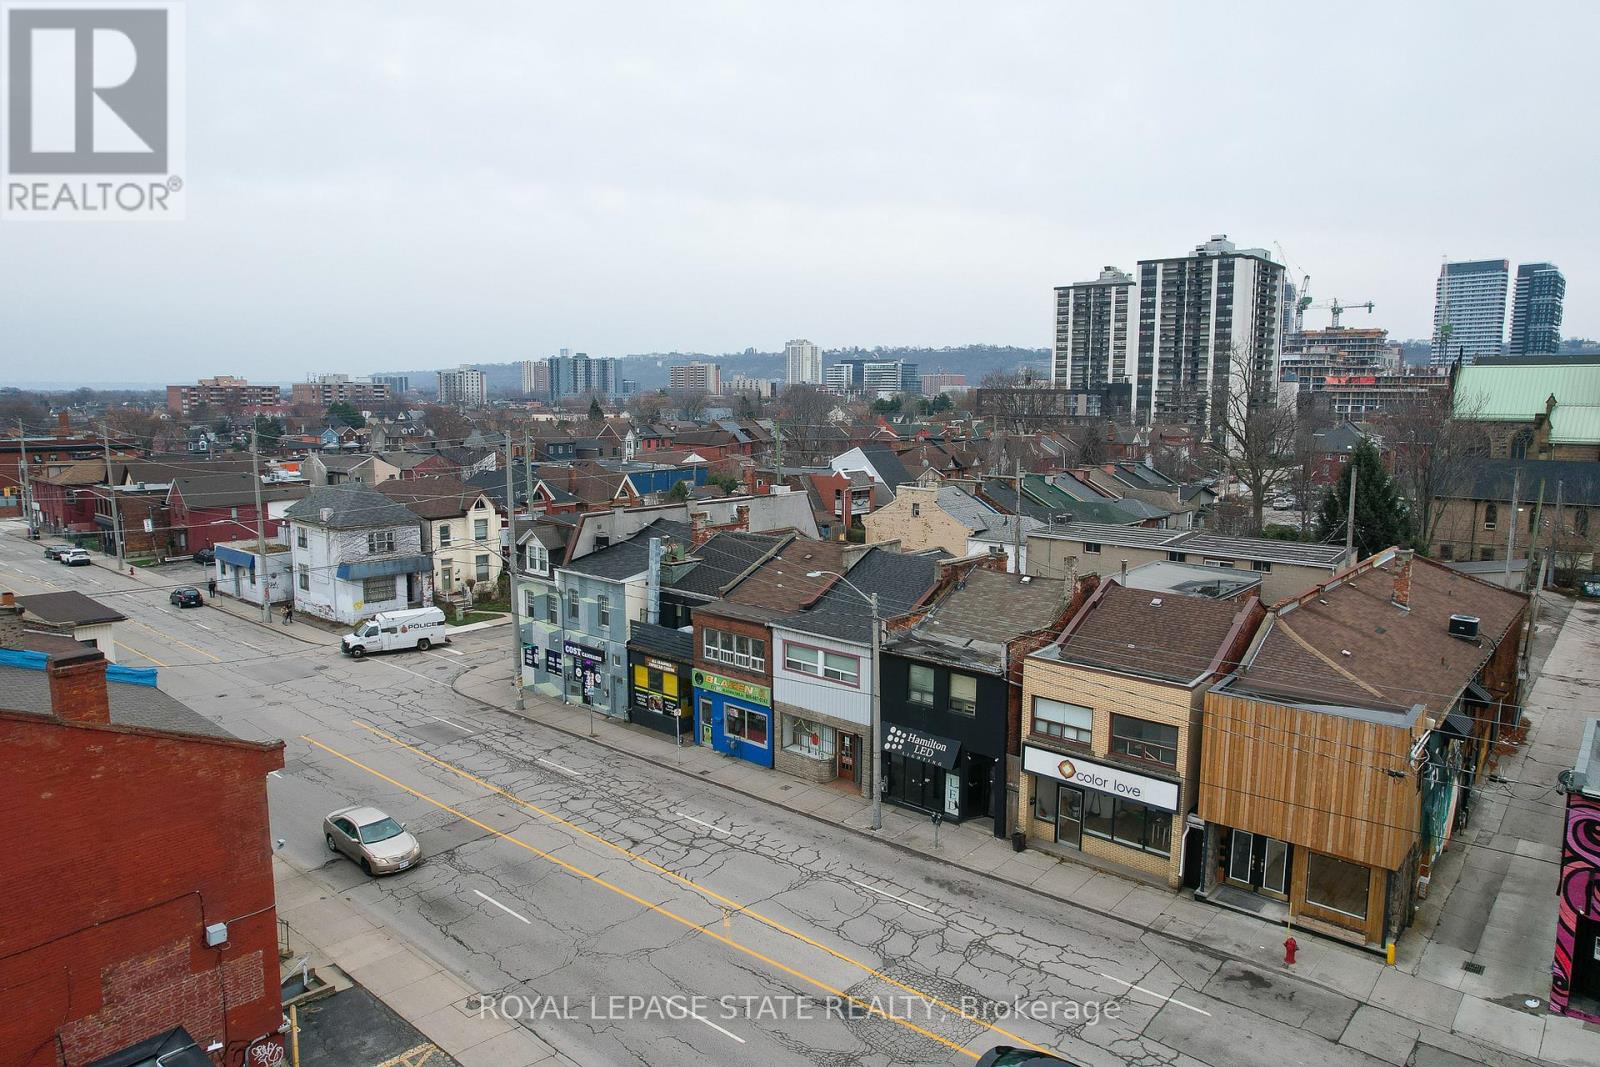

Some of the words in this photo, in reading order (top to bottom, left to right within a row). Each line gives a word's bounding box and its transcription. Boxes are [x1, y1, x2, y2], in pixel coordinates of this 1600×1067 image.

[408, 622, 437, 630] POLICE
[565, 645, 582, 656] COST
[907, 733, 947, 752] Hamilton
[914, 745, 934, 757] LED
[1076, 772, 1108, 788] color
[1114, 779, 1141, 797] love
